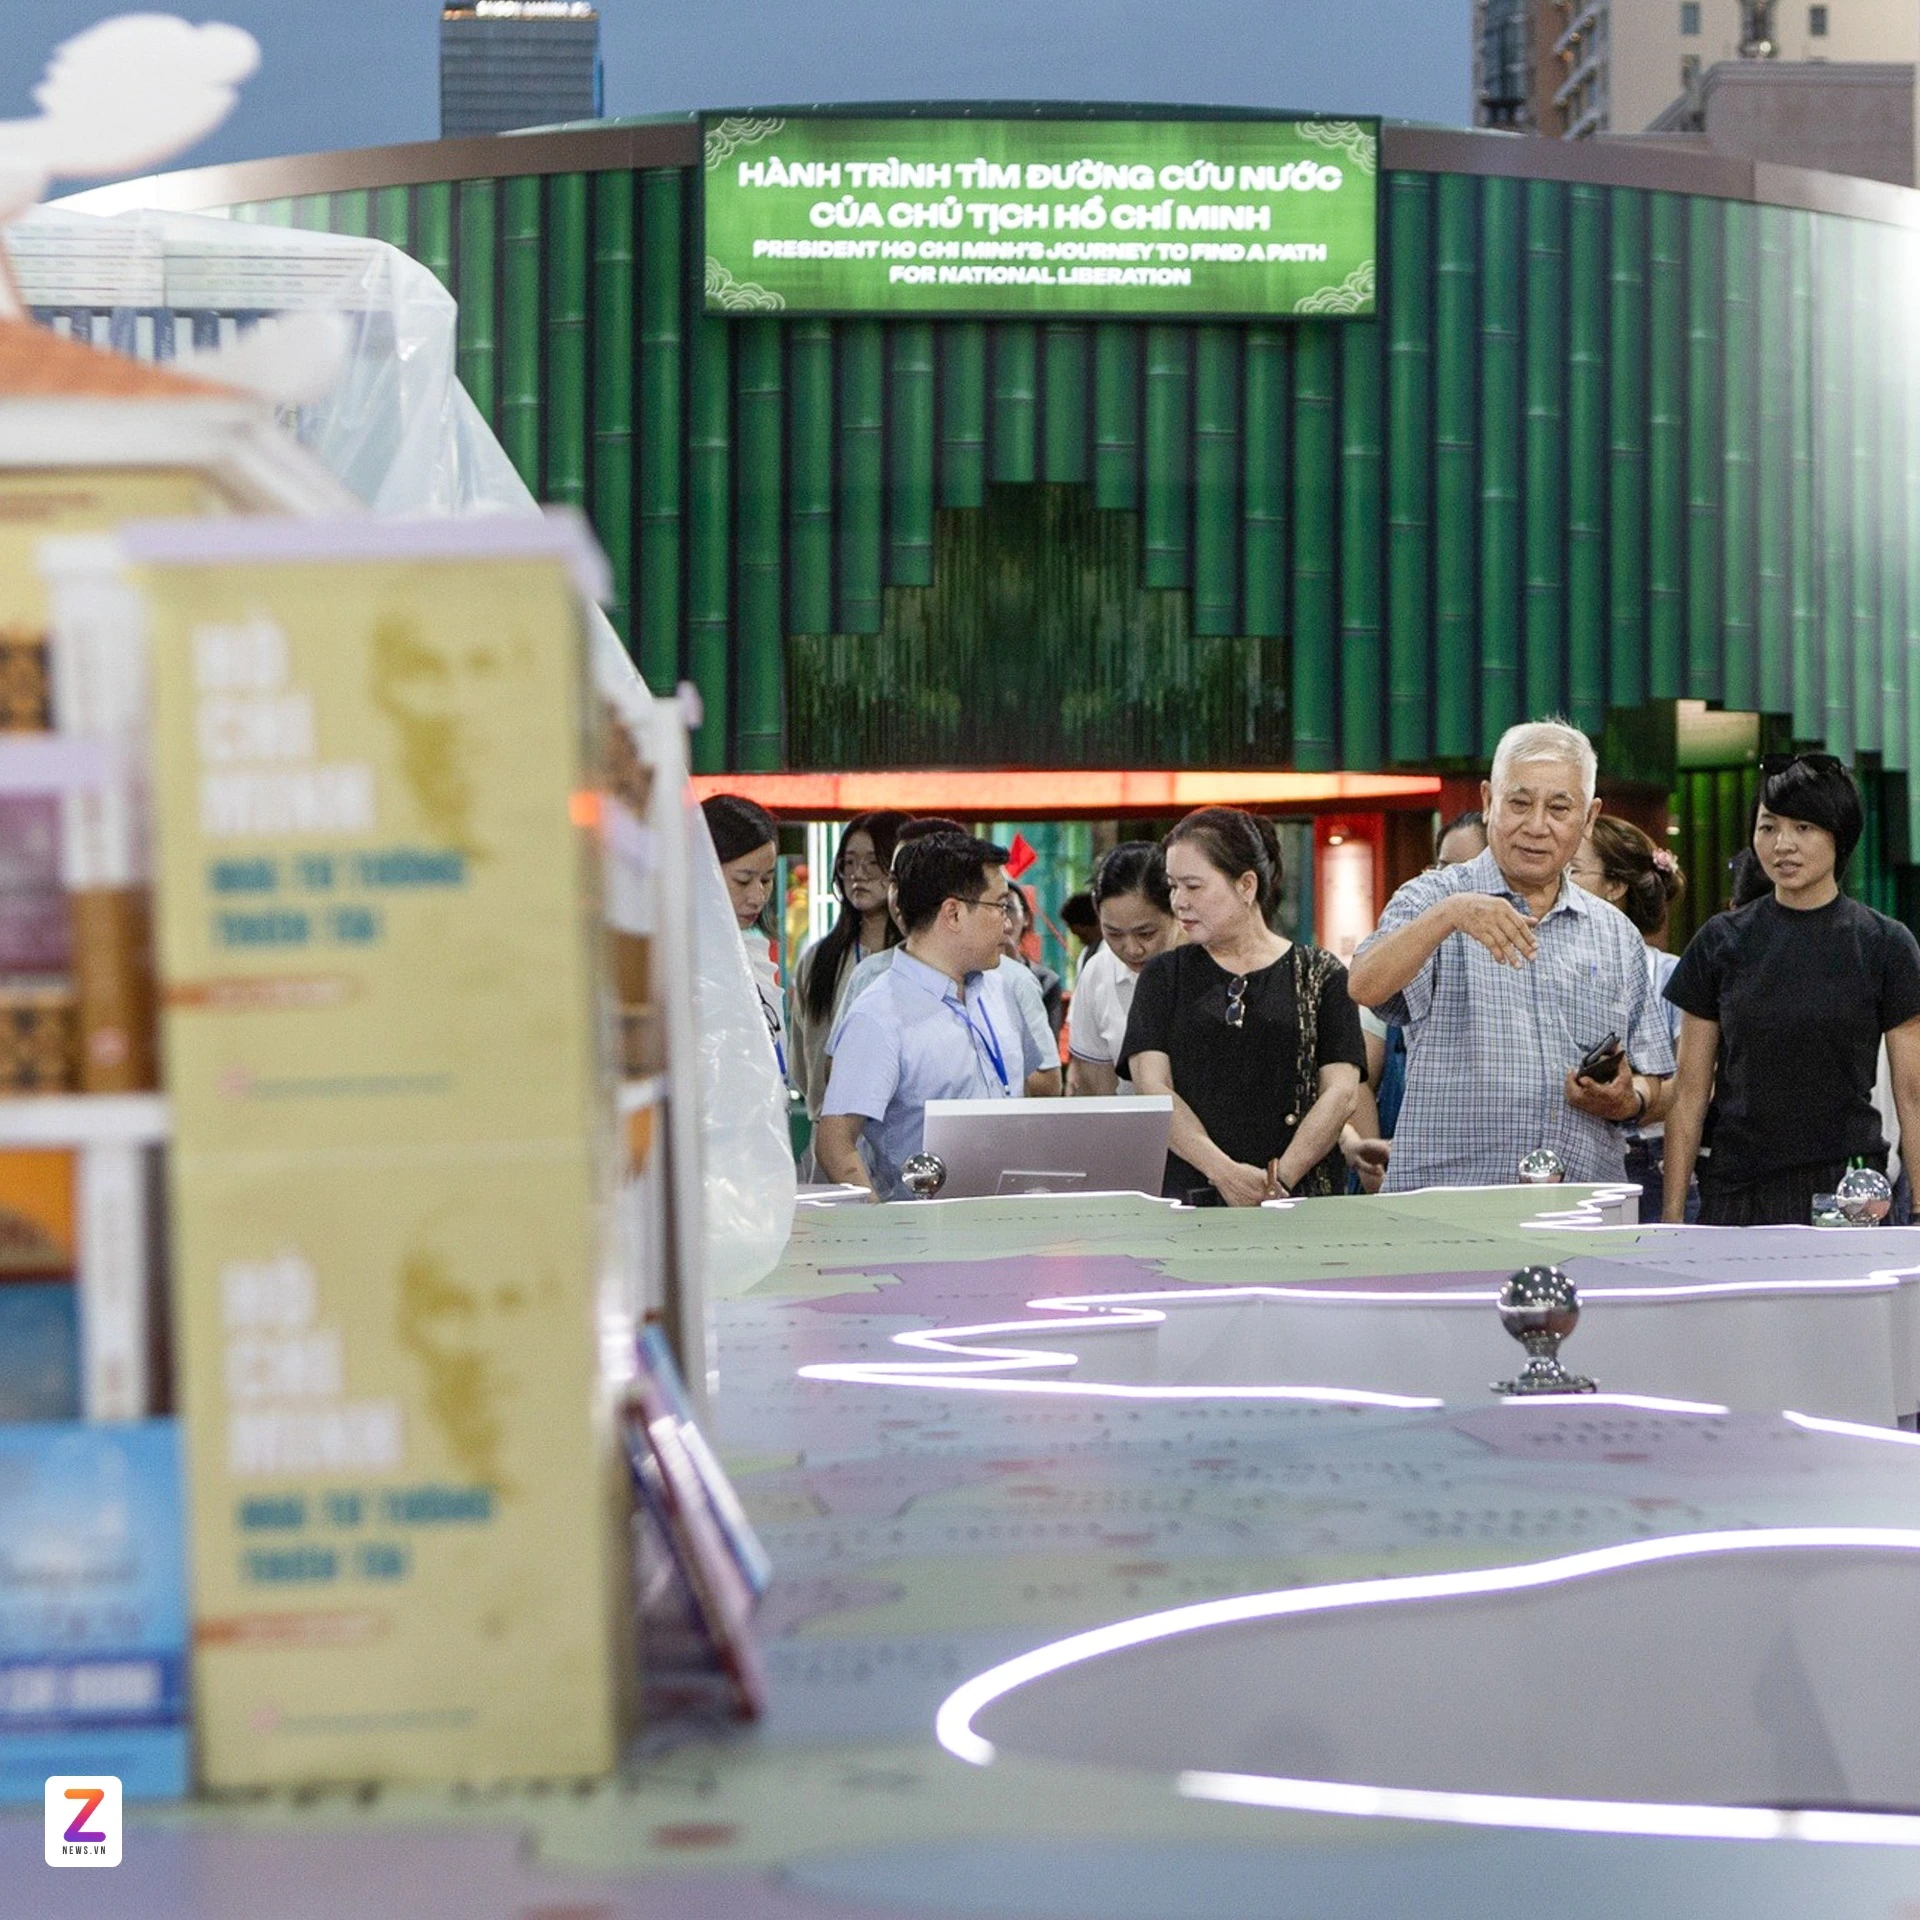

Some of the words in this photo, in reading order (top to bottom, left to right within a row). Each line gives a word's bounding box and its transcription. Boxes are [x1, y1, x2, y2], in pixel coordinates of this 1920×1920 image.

[738, 156, 841, 188] HÀNH
[844, 157, 950, 188] TRÌNH
[954, 158, 1021, 189] TÌM
[1025, 159, 1155, 190] ĐƯỜNG
[1159, 160, 1235, 191] CỨU
[1239, 160, 1343, 191] NƯỚC
[809, 195, 885, 228] CỦA
[887, 195, 963, 228] CHỦ
[966, 203, 1049, 235] TỊCH
[1053, 195, 1107, 229] HỒ
[1110, 199, 1174, 230] CHÍ
[1176, 205, 1271, 231] MINH
[753, 240, 880, 259] PRESIDENT
[881, 241, 917, 259] HO
[919, 241, 960, 259] CHI
[962, 241, 1044, 260] MINH'S
[1046, 242, 1156, 261] JOURNEY
[1157, 243, 1189, 261] TO
[1190, 243, 1246, 261] FIND
[1246, 244, 1266, 261] A
[1266, 244, 1327, 261] PATH
[889, 265, 936, 284] FOR
[939, 266, 1056, 285] NATIONAL
[1058, 267, 1191, 286] LIBERATION
